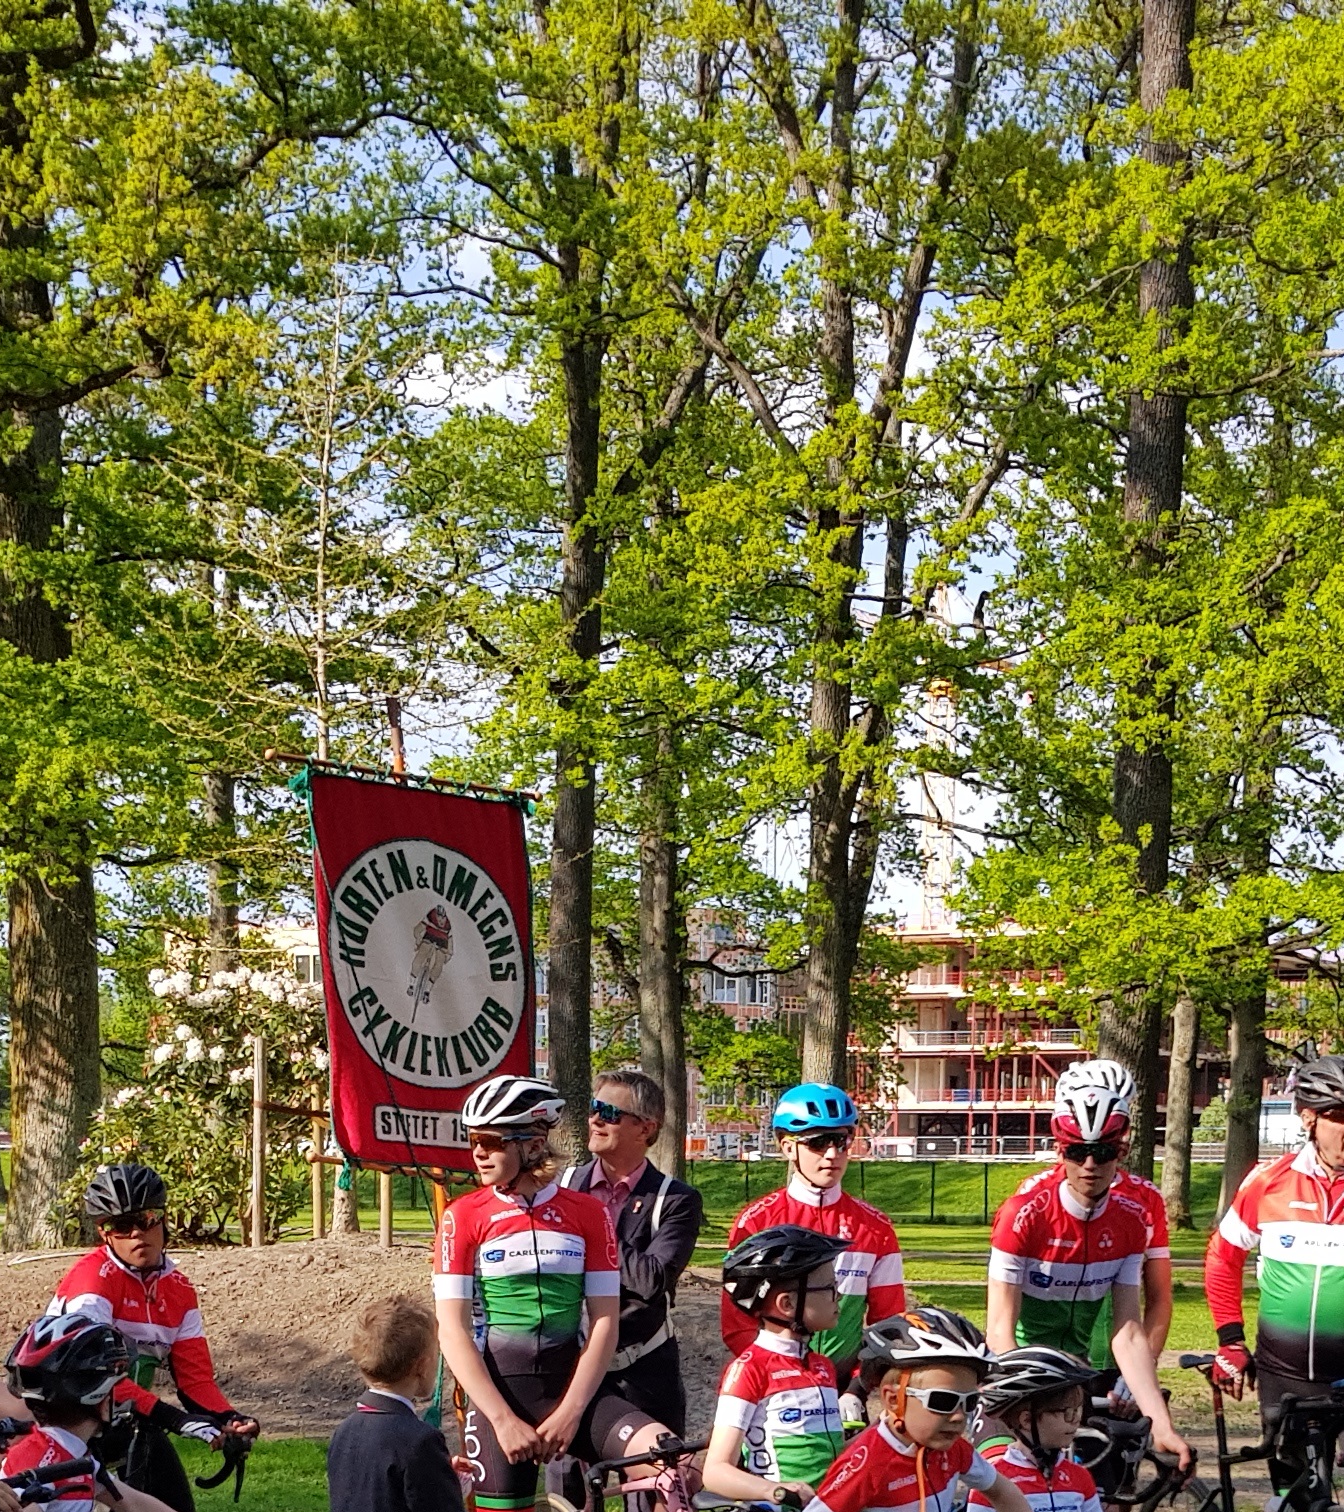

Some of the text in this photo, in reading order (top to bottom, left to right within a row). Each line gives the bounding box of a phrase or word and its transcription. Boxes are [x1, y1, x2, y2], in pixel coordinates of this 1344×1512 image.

[339, 849, 517, 982] HORTEN & OMEGNS
[348, 986, 514, 1078] CYKLEKLUBB
[381, 1111, 440, 1141] STFTET
